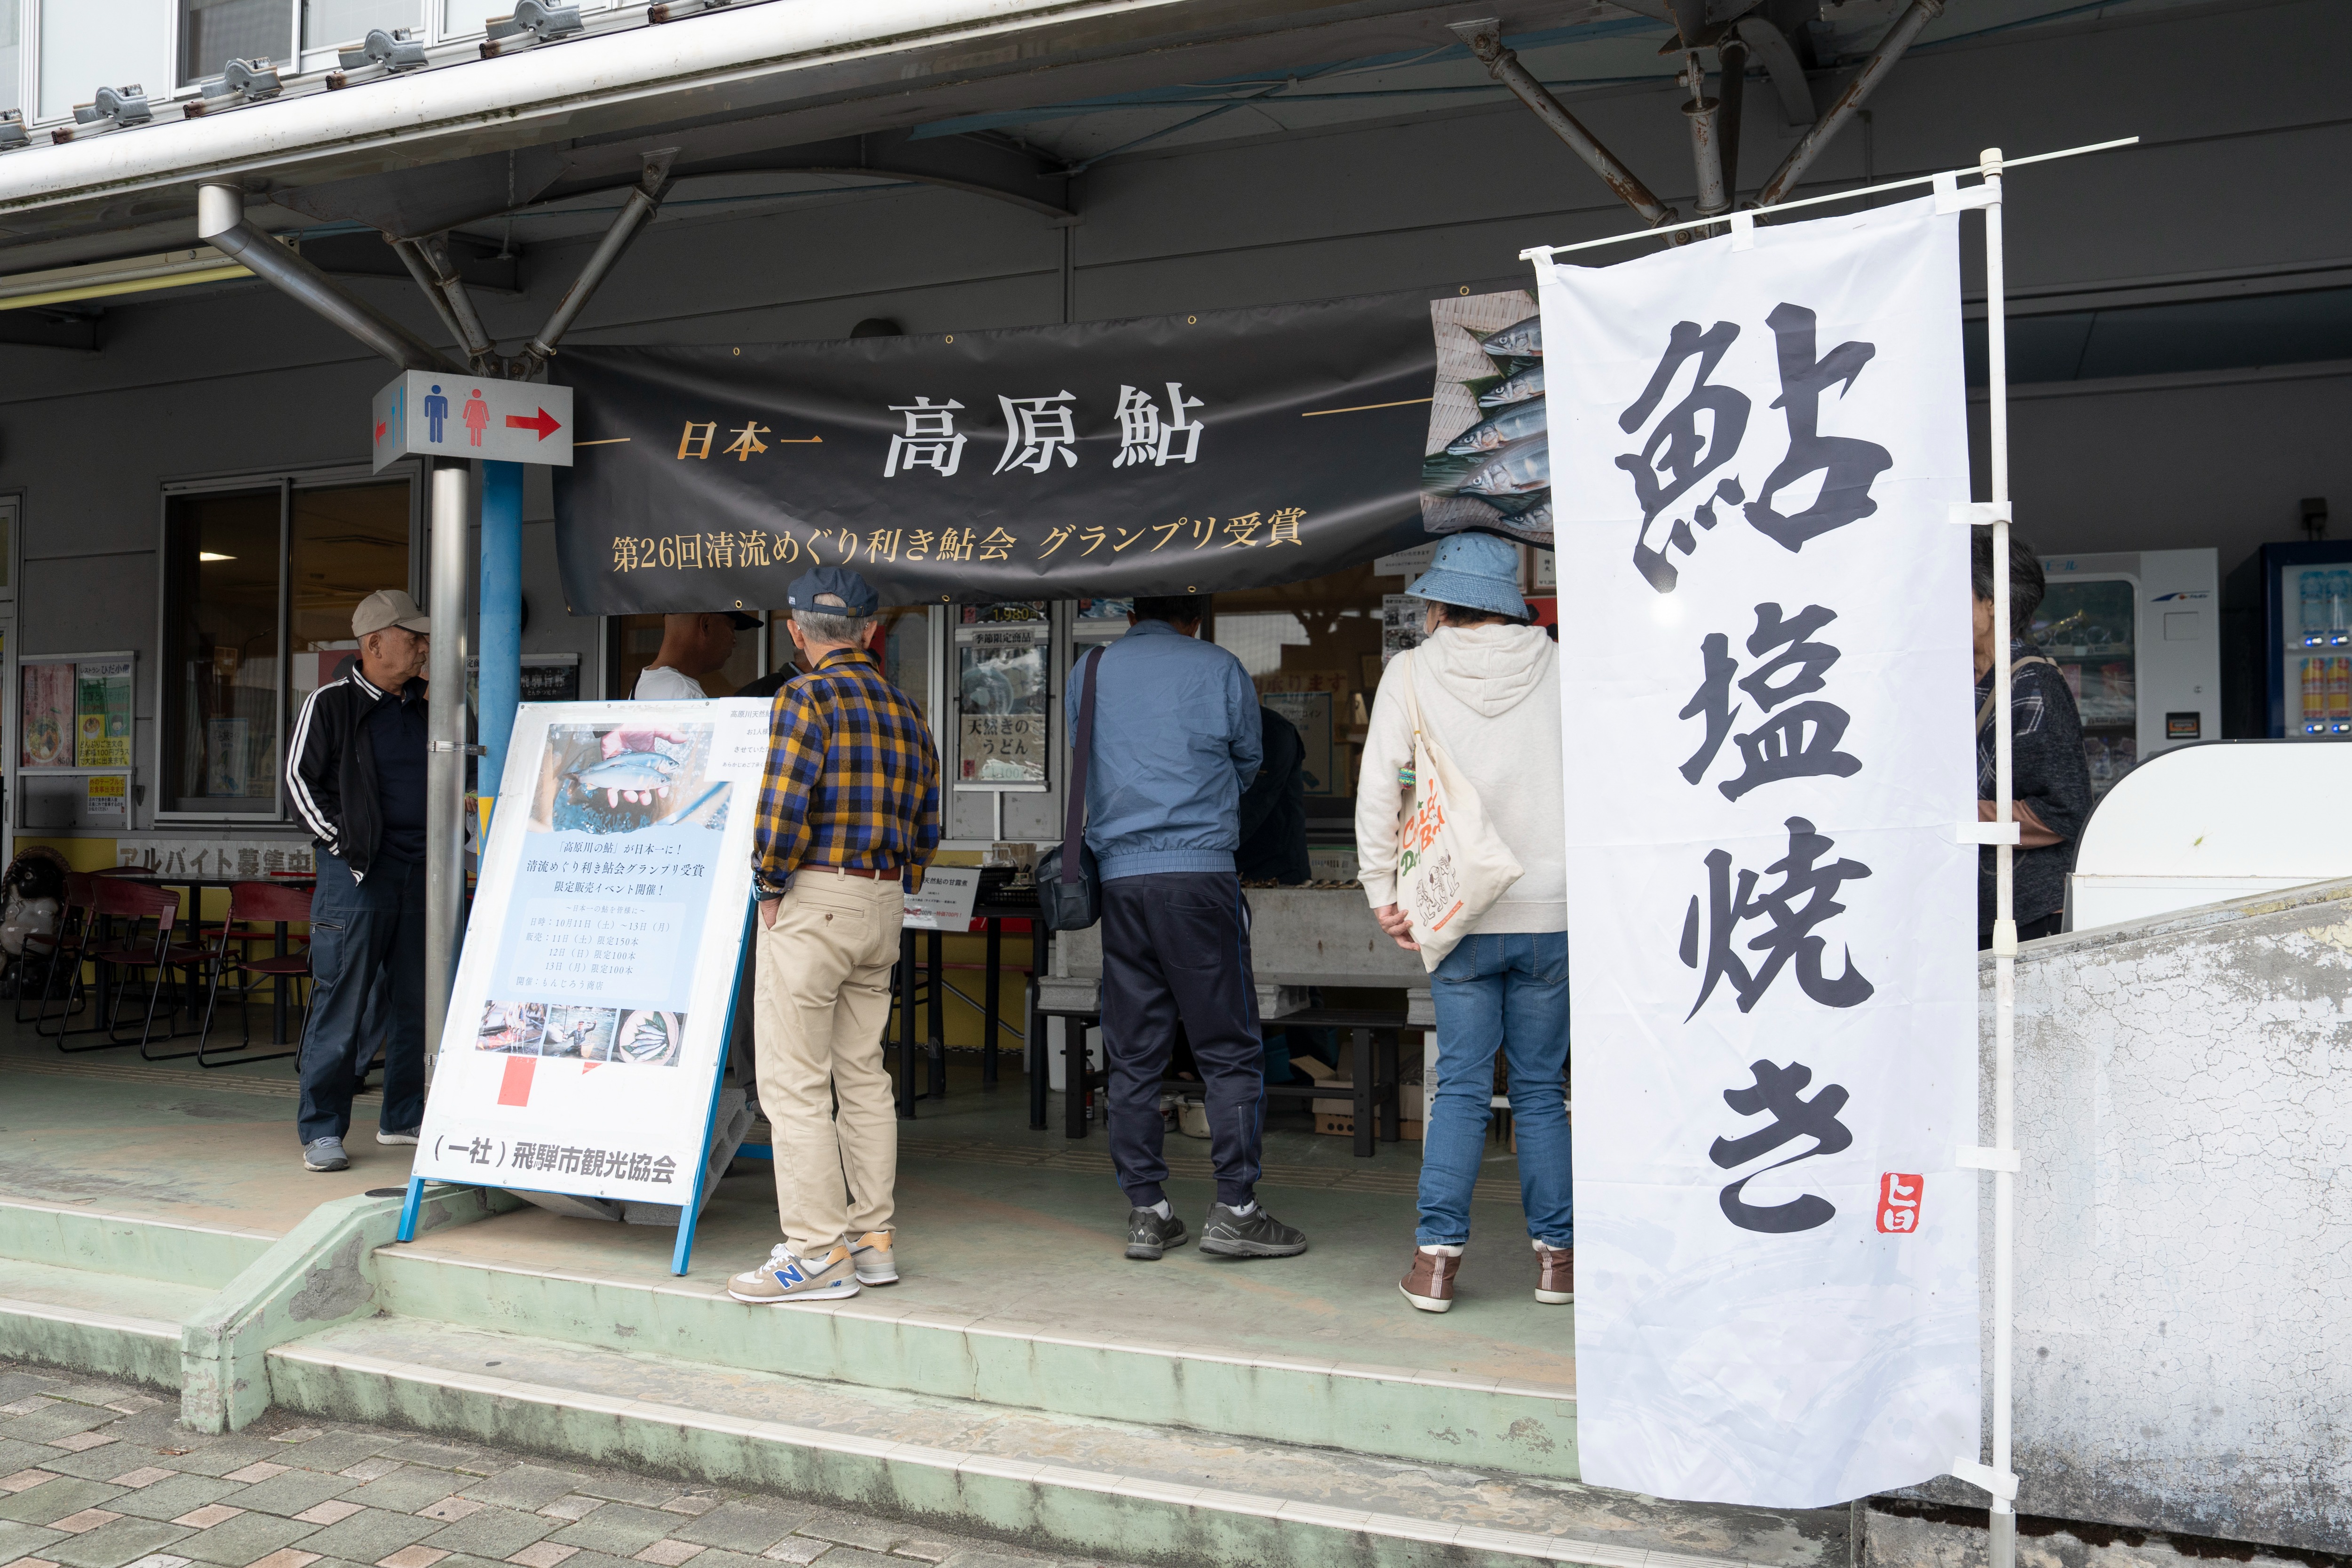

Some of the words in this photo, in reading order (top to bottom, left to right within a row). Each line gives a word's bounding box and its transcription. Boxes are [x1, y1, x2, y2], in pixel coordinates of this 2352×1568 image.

[677, 421, 823, 462] 日本一
[883, 382, 1205, 478] 高原鮎
[612, 526, 1017, 573] 第26回清流めぐり利き鮎会
[1037, 507, 1307, 560] グランプリ受賞
[975, 632, 1031, 644] 季節限定商品
[983, 739, 1029, 755] うどん
[1615, 302, 1895, 1234] 鮎塩焼き
[120, 847, 310, 876] アルバイト募集中
[526, 860, 706, 878] 清流めぐり利き鮎会グランプリ受賞
[554, 881, 664, 896] 限定販売イベント開催！
[773, 1264, 806, 1290] N
